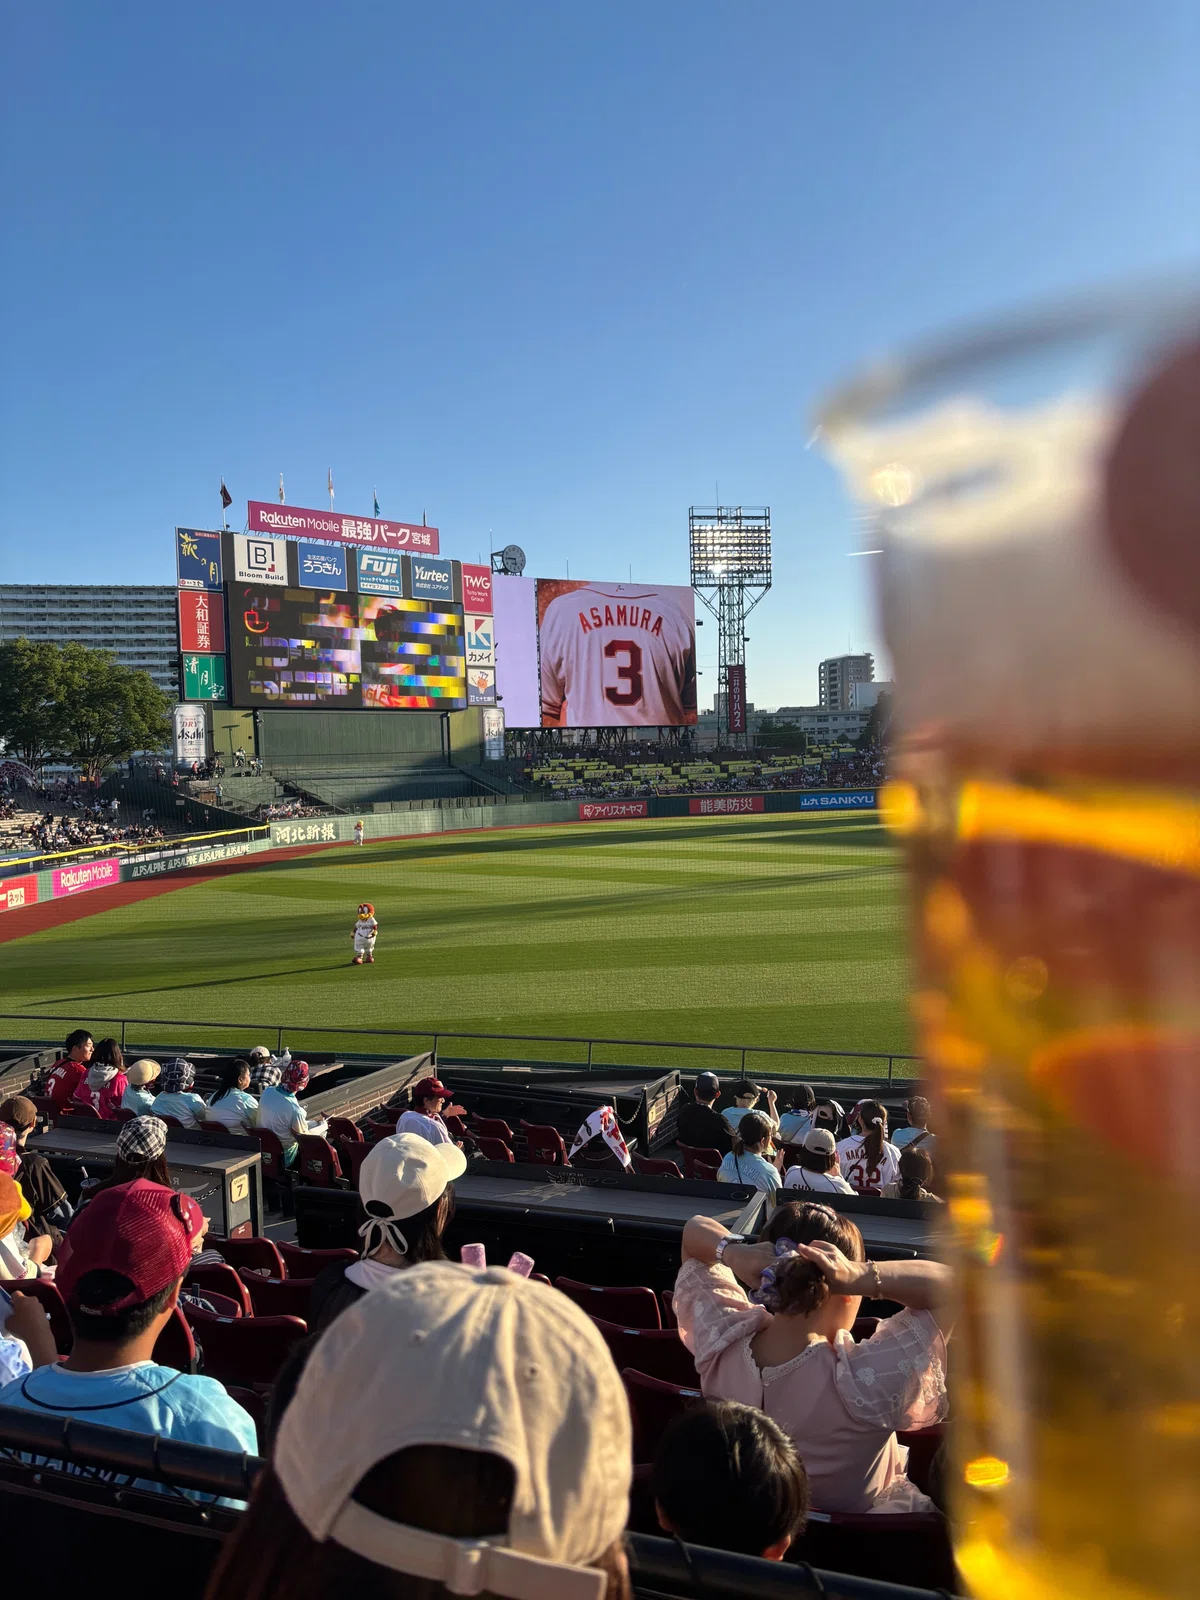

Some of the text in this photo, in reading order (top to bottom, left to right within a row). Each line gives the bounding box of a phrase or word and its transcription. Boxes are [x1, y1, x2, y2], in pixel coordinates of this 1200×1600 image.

[259, 510, 306, 528] Rakuten
[307, 517, 340, 533] Mobile
[303, 560, 342, 576] ろうきん
[360, 554, 398, 576] Fuji
[239, 571, 284, 581] Bloom Build
[415, 565, 449, 583] Yurtec
[464, 575, 490, 589] TWG
[471, 595, 485, 603] Group
[195, 595, 210, 649] 大和証券
[578, 604, 663, 637] ASAMURA
[468, 652, 492, 663] カメイ
[185, 656, 225, 699] 清月記
[603, 639, 643, 707] 3
[733, 670, 741, 728] 三井のリハウス
[178, 728, 204, 740] Asahi
[700, 798, 753, 813] 能美防災
[820, 795, 875, 805] SANKYU
[594, 804, 643, 817] アイリスオーヤマ
[276, 822, 336, 844] 河北新報
[60, 862, 113, 888] Rakuten Mobile
[9, 890, 24, 905] ネット
[236, 1183, 244, 1197] 7
